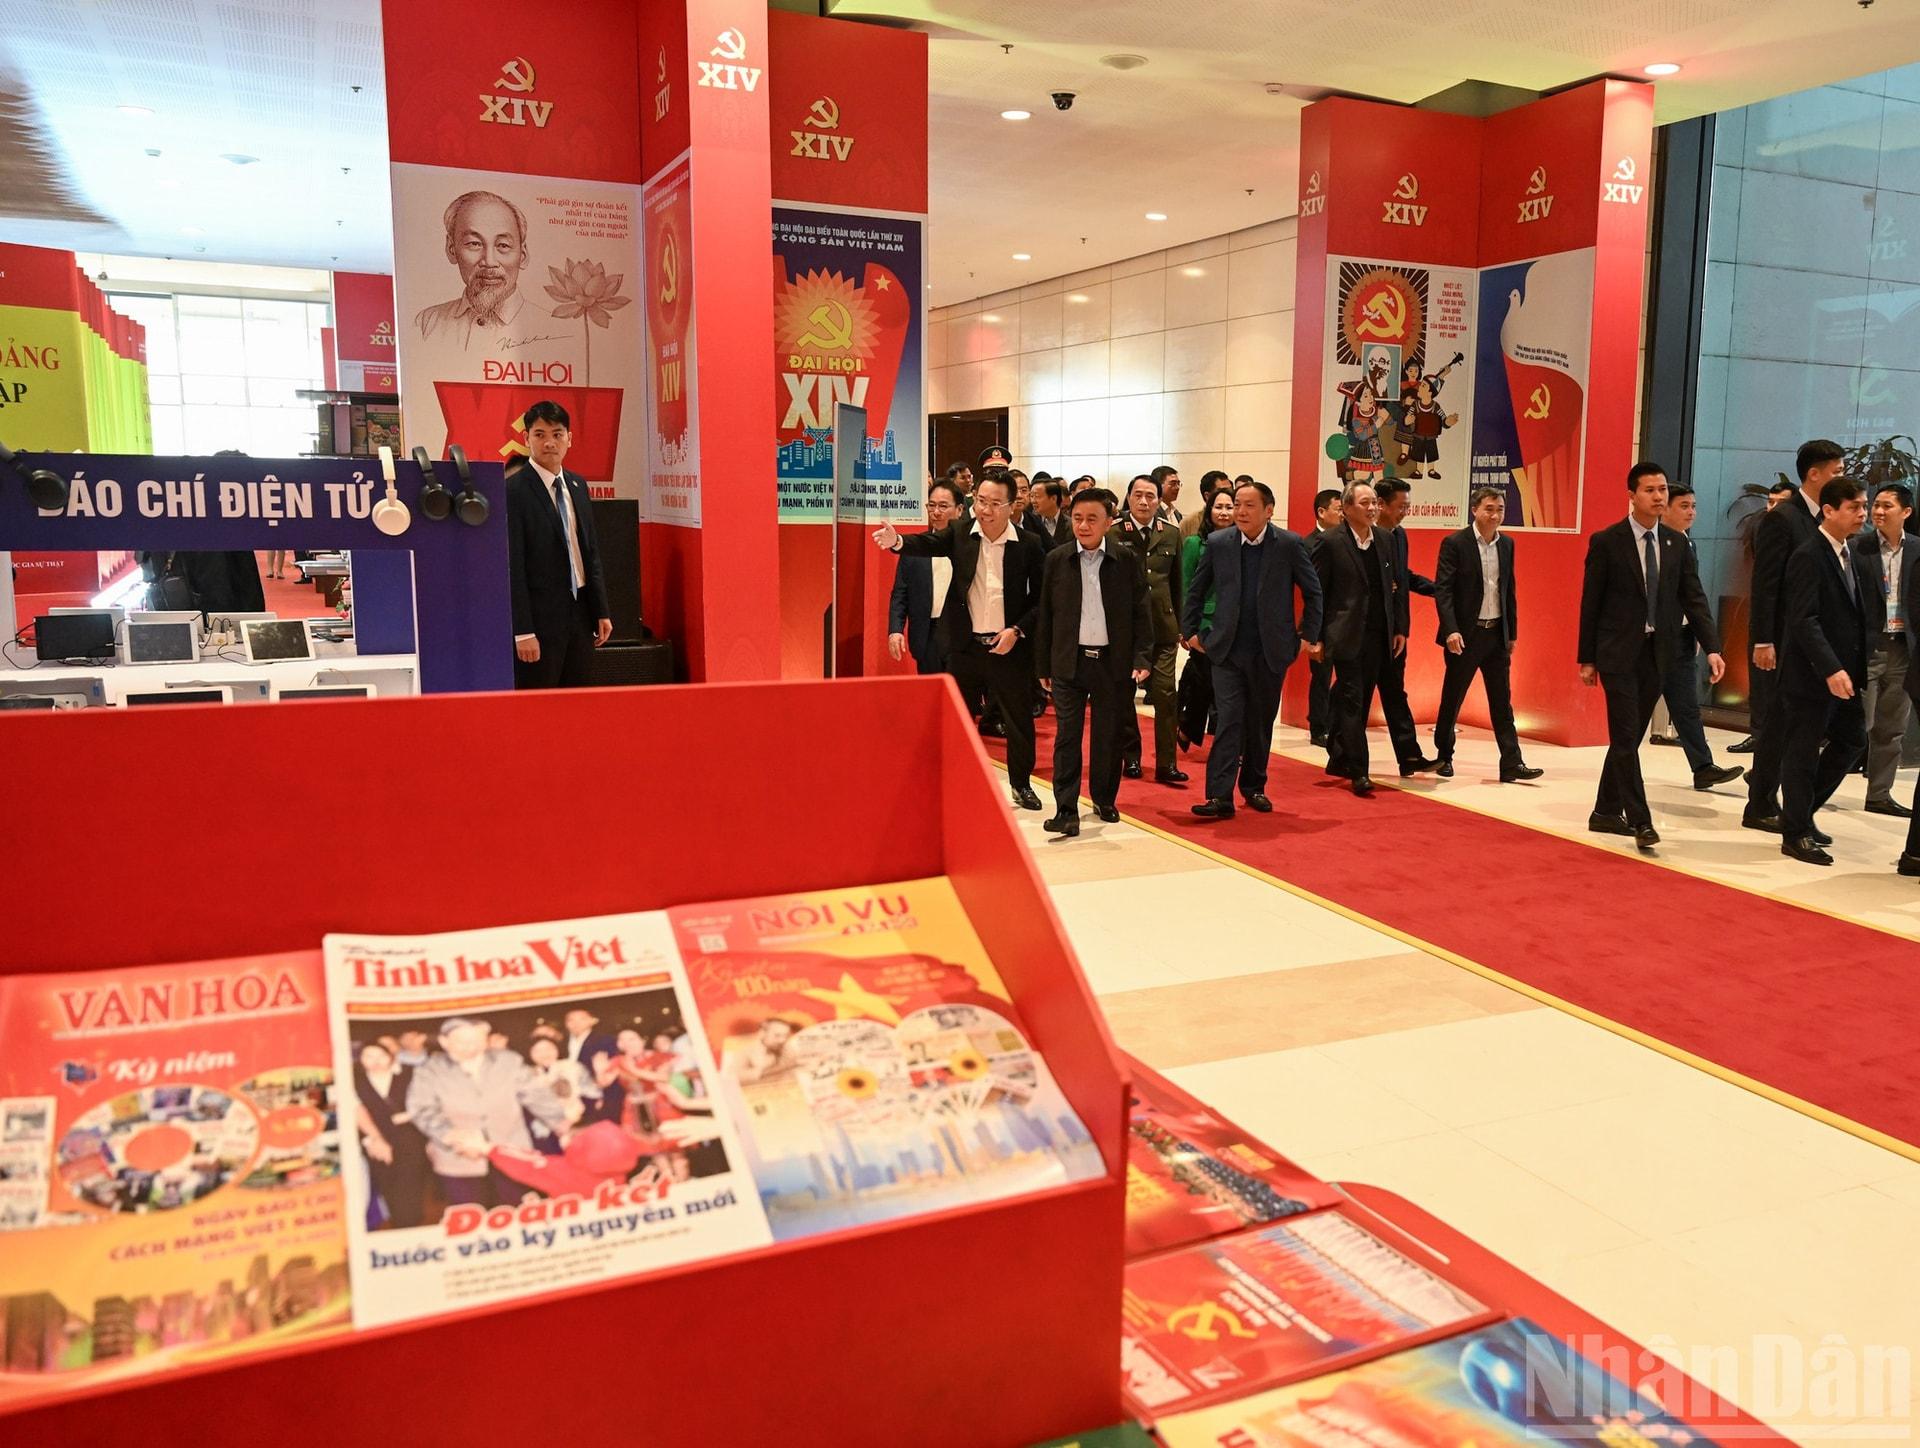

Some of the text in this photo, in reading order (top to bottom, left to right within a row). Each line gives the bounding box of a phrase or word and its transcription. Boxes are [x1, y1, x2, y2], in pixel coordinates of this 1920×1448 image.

[698, 61, 761, 92] XIV
[479, 94, 553, 128] XIV
[655, 83, 670, 122] XIV
[791, 131, 854, 162] XIV
[1301, 195, 1326, 217] XIV
[1603, 183, 1643, 205] XIV
[1382, 202, 1427, 226] XIV
[1517, 195, 1554, 223] XIV
[782, 232, 816, 245] CỘNG
[820, 236, 844, 247] SẢN
[848, 239, 874, 250] VIỆT
[878, 243, 904, 252] NAM
[483, 360, 573, 386] ĐẠI HỘI
[789, 355, 863, 375] ĐẠI HỘI
[662, 361, 681, 403] XIV
[782, 372, 870, 430] XIV
[37, 470, 374, 527] ÁO CHÍ ĐIỆN TỬ
[794, 482, 812, 494] NƯỚC
[814, 484, 827, 496] VIỆT
[880, 485, 892, 496] ĐỘC
[894, 484, 908, 498] LẬP,
[782, 498, 804, 510] MẠNH,
[881, 500, 898, 511] HẠNH
[900, 498, 919, 510] PHÚC!
[1421, 500, 1430, 516] CỦA
[1432, 501, 1441, 516] ĐẤT
[457, 954, 536, 985] hoa
[524, 936, 628, 982] Việt
[733, 975, 771, 998] 100
[442, 1165, 673, 1239] Đoàn kết
[457, 1233, 512, 1259] vào
[568, 1204, 676, 1239] nguyên
[685, 1188, 739, 1217] mới
